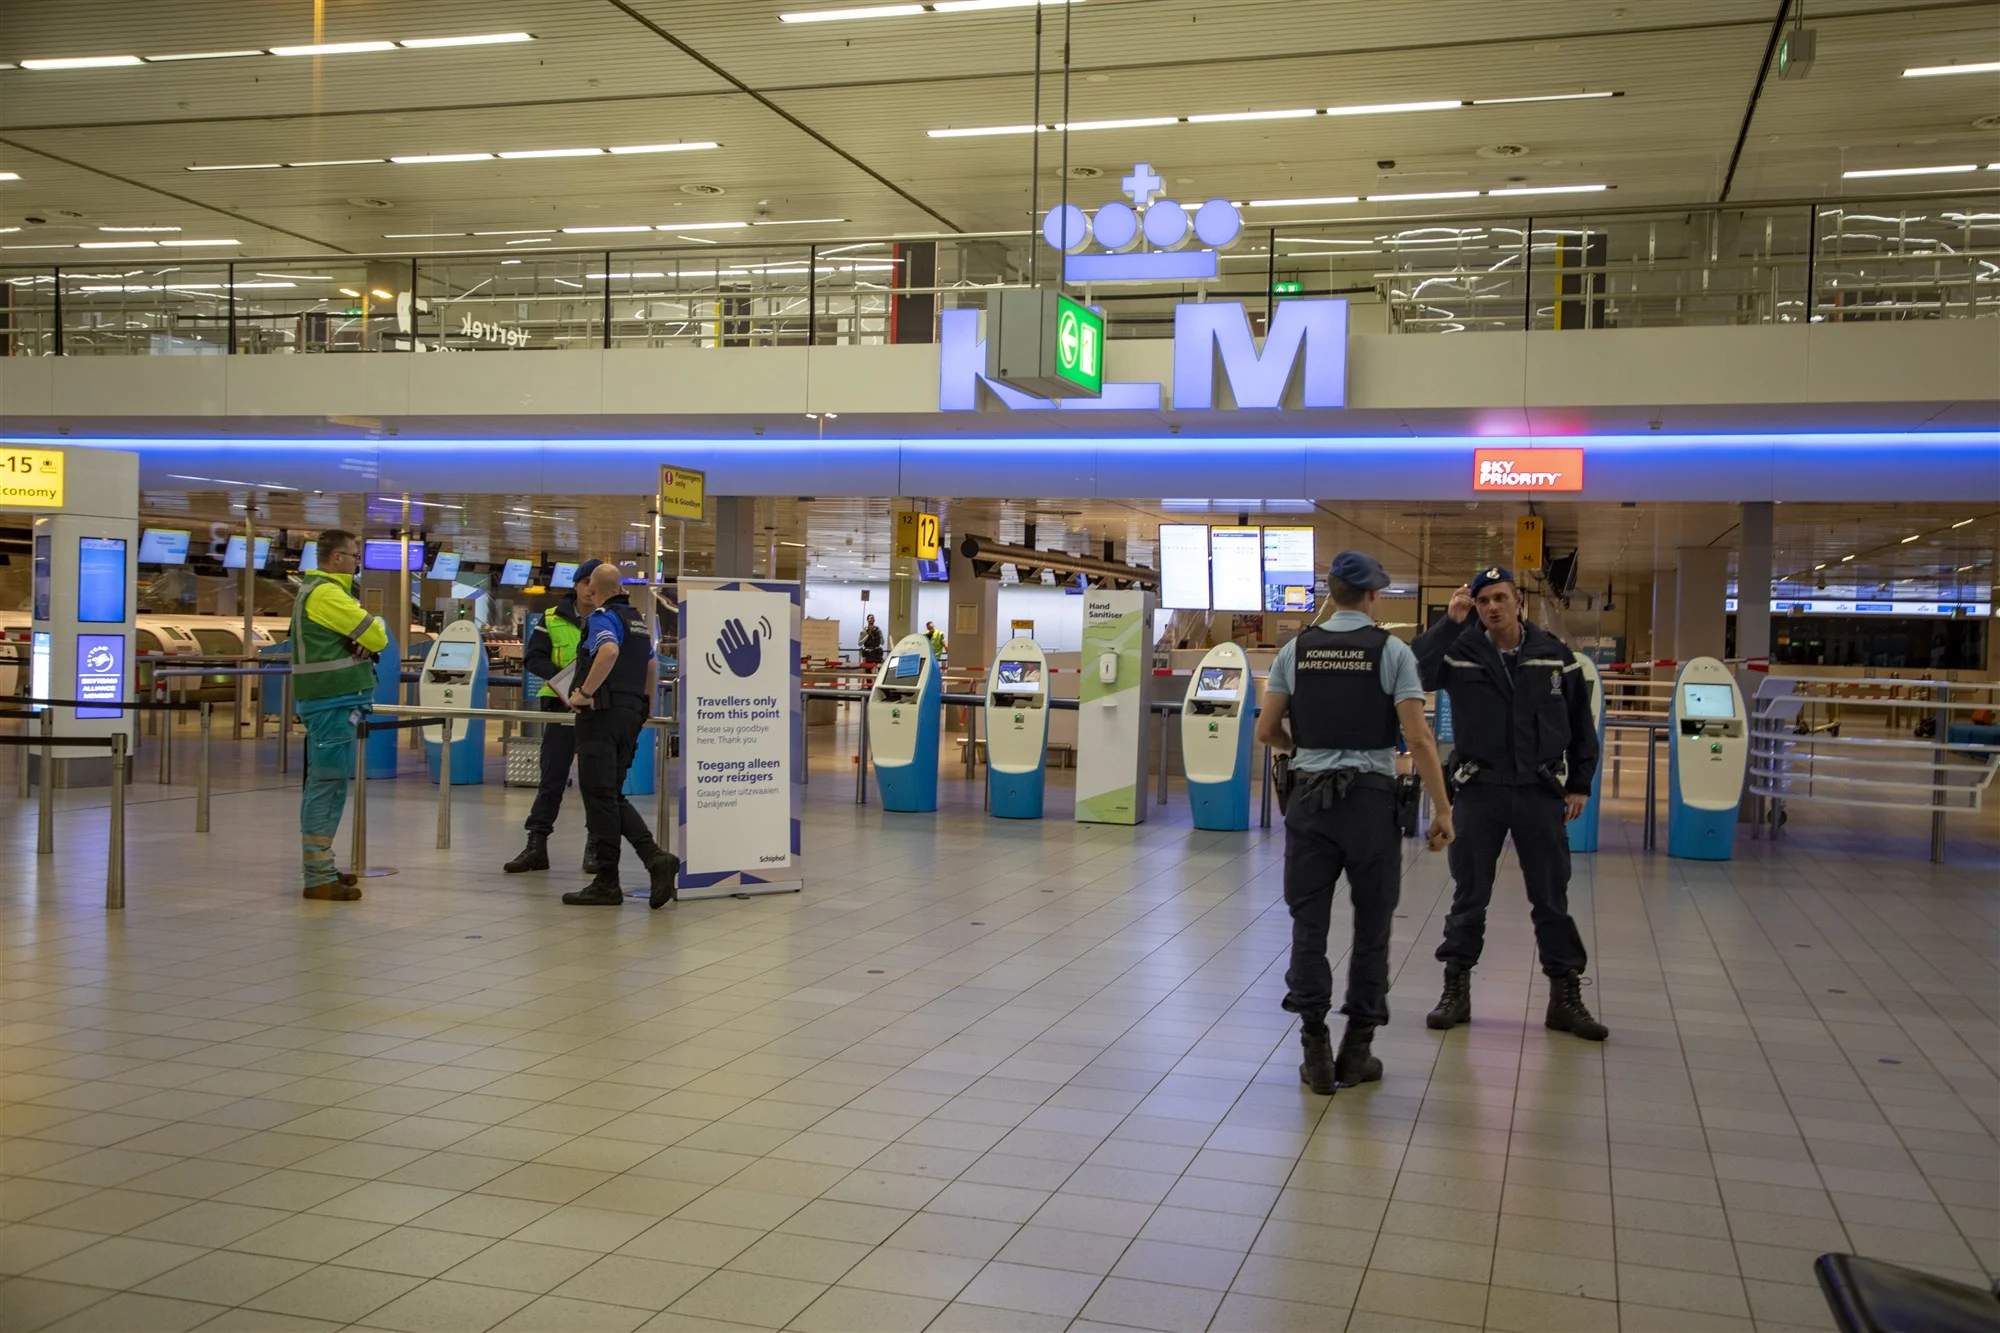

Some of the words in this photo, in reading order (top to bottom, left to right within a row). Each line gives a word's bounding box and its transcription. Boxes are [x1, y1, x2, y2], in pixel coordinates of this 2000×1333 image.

[1480, 461, 1515, 474] SKY
[1480, 472, 1562, 486] PRIORITY
[0, 487, 57, 500] conomy
[903, 516, 913, 525] 12
[1524, 521, 1535, 530] 11
[921, 518, 935, 547] 12
[1089, 611, 1123, 619] Sanitiser
[1306, 650, 1365, 659] KONINKLIJKE
[1298, 661, 1373, 671] MARECHAUSSEE
[697, 696, 751, 707] Travellers
[753, 696, 777, 708] only
[697, 709, 725, 720] from
[728, 708, 749, 719] this
[751, 709, 780, 721] point
[697, 725, 721, 733] Please
[723, 726, 735, 734] say
[736, 724, 769, 734] goodbye
[718, 735, 741, 744] Thank
[743, 737, 757, 745] you
[697, 760, 745, 773] Toegang
[748, 758, 780, 769] alleen
[697, 774, 723, 783] voor
[726, 772, 773, 784] reizigers
[697, 789, 720, 799] Graag
[722, 787, 737, 796] hier
[697, 799, 737, 810] Dankjewel
[760, 853, 785, 863] Schiphol
